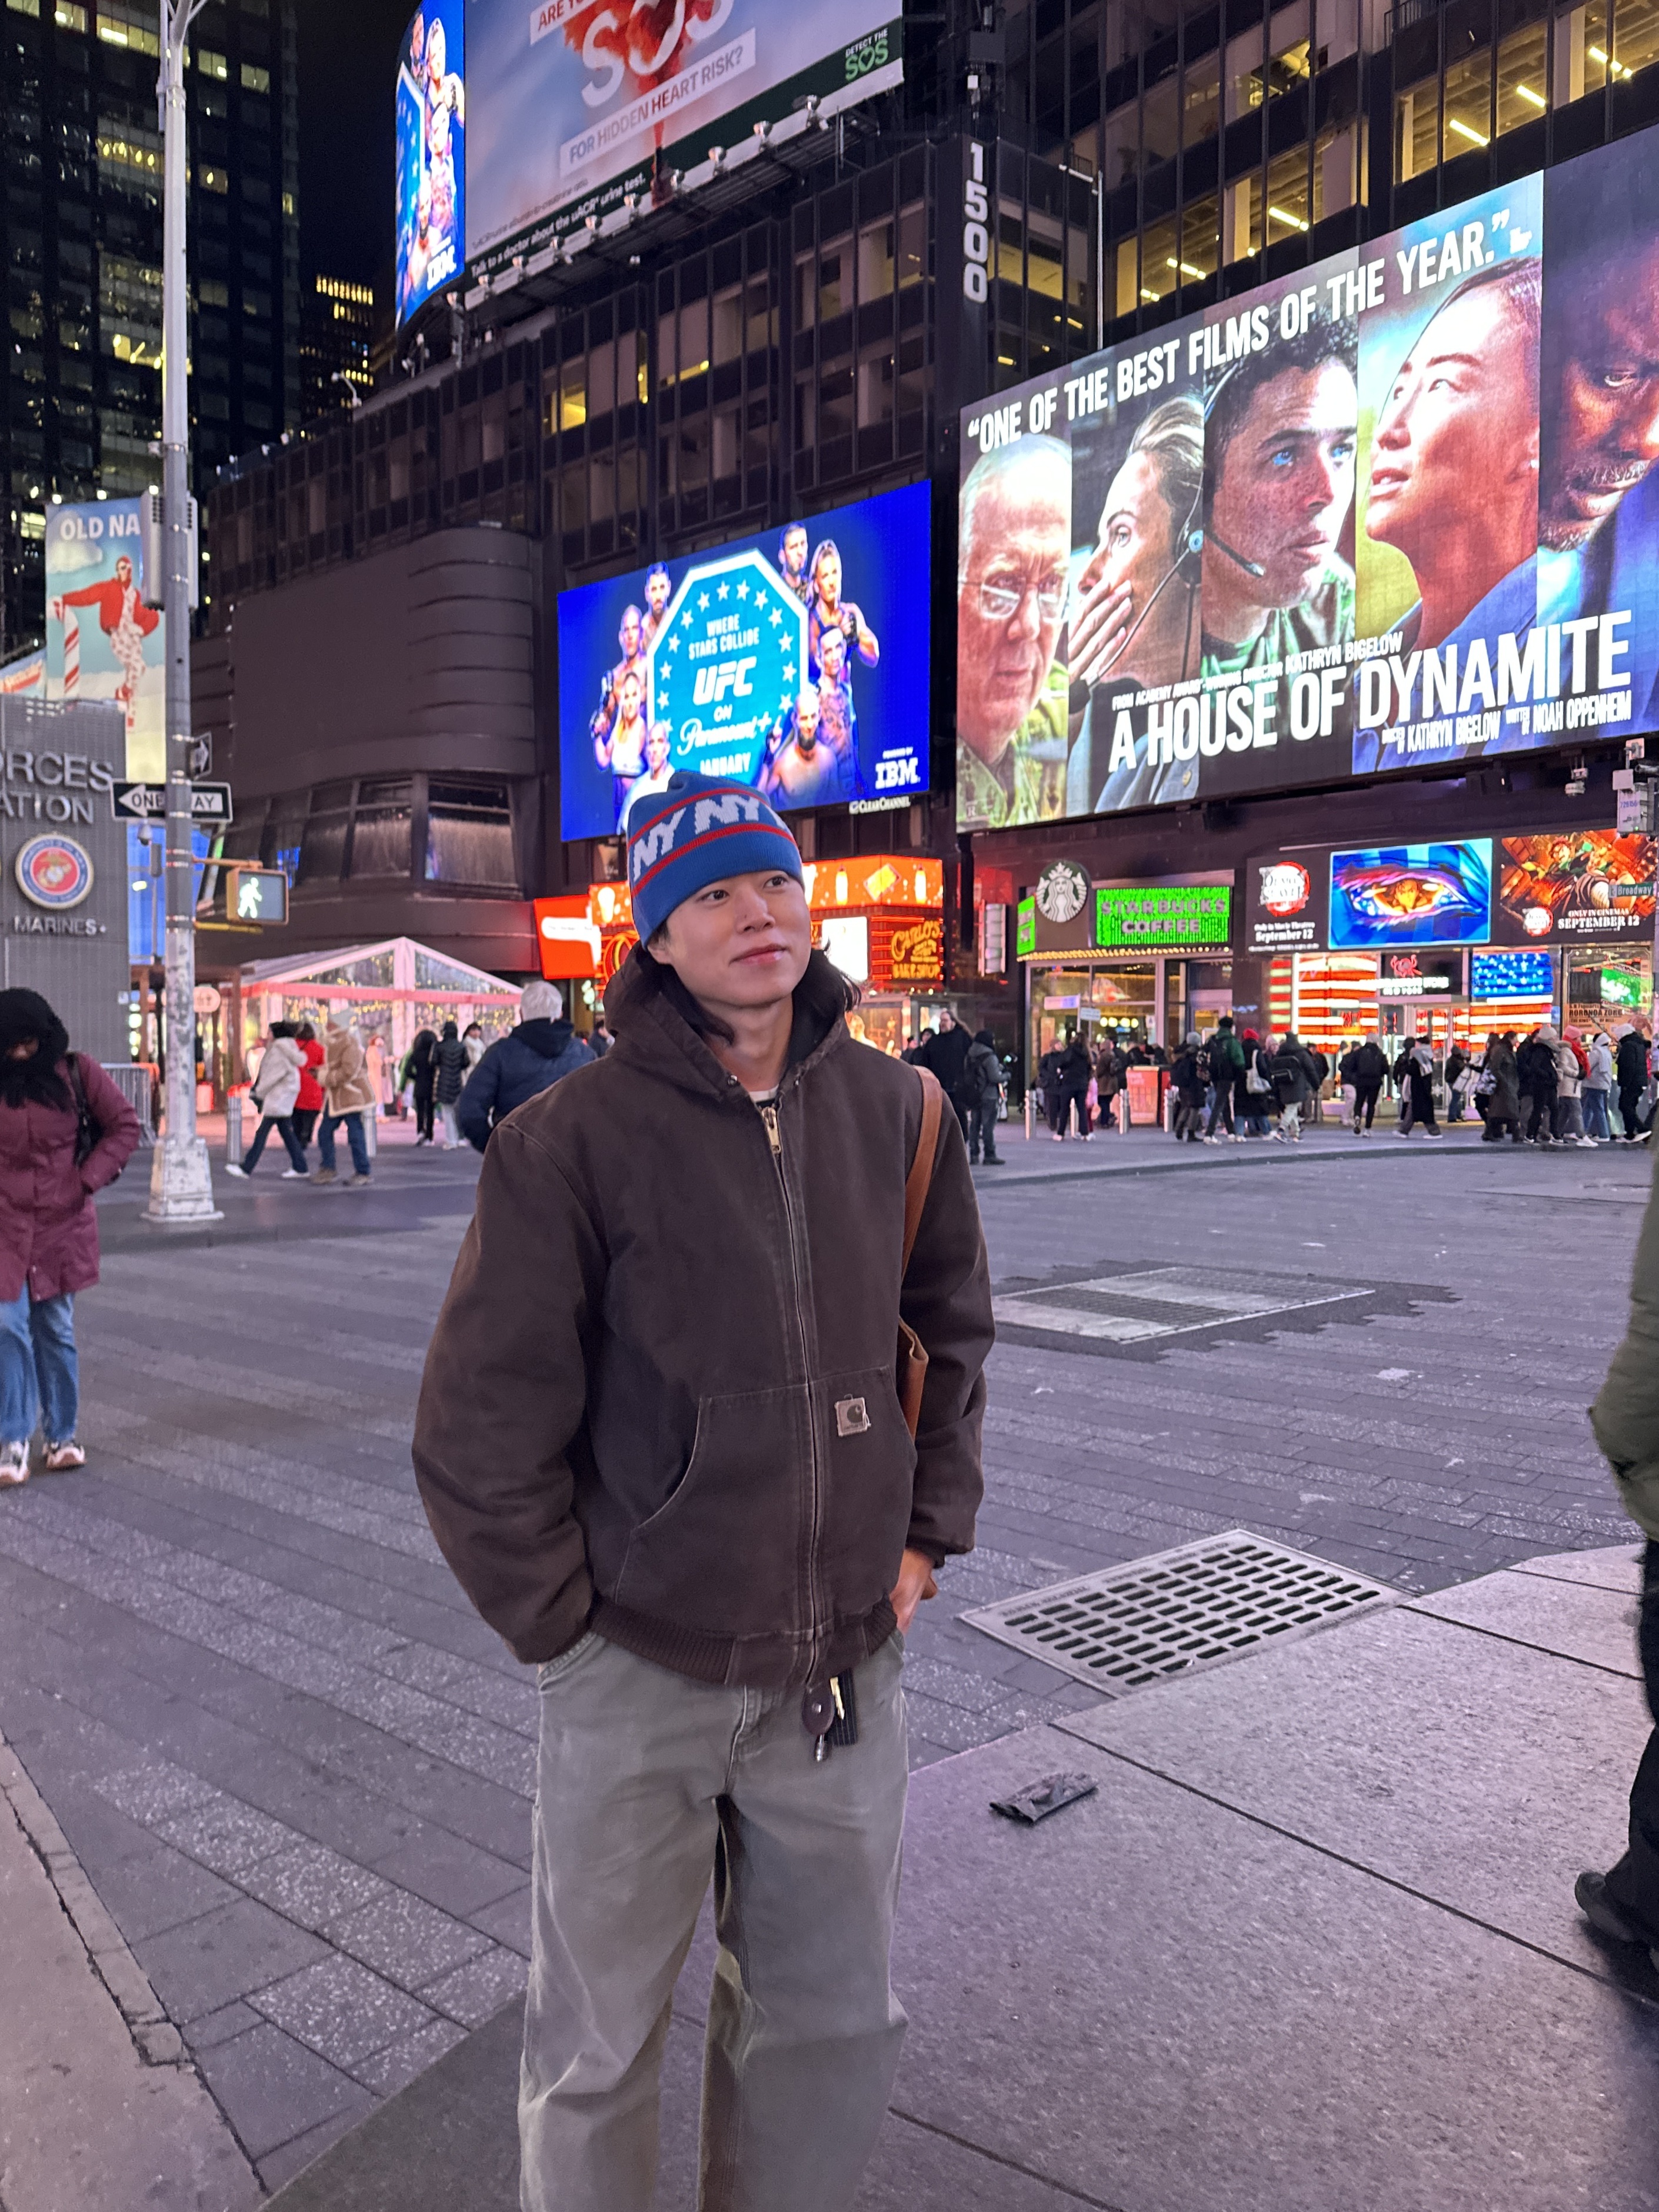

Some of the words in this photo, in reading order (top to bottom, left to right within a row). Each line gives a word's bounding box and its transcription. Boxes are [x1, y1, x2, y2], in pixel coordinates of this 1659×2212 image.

[538, 0, 565, 31] ARE
[845, 36, 872, 58] DETECT
[874, 28, 888, 42] THE
[845, 38, 889, 81] SOS
[569, 135, 595, 164] FOR
[597, 102, 647, 147] HIDDEN
[651, 71, 699, 115] HEART
[701, 45, 744, 85] RISK?
[471, 258, 487, 278] Talk
[488, 256, 497, 268] to
[504, 237, 530, 261] doctor
[531, 222, 554, 245] about
[555, 214, 570, 231] the
[599, 184, 624, 206] urine
[964, 142, 988, 304] 1500
[1029, 387, 1058, 434] OF
[1064, 367, 1108, 421] THE
[1117, 339, 1180, 402] BEST
[1188, 305, 1270, 376] FILMS
[1280, 285, 1317, 340] OF
[1327, 258, 1385, 322] THE
[61, 517, 104, 541] OLD
[109, 513, 141, 538] NA
[707, 614, 740, 638] WHERE
[688, 638, 718, 661] STARS
[719, 627, 760, 653] COLLIDE
[692, 656, 757, 705] UFC
[1112, 692, 1134, 711] FROM
[1135, 685, 1172, 707] ACADEMY
[1242, 662, 1284, 685] DIRECTOR
[1286, 645, 1342, 675] KATHRYN
[1344, 631, 1404, 662] BIGELOW
[1108, 710, 1137, 773] A
[1147, 680, 1279, 767] HOUSE
[1290, 666, 1347, 741] OF
[1359, 609, 1633, 729] DYNAMITE
[714, 704, 733, 722] ON
[1407, 718, 1453, 754] KATHRYN
[1455, 711, 1501, 746] BIGELOW
[1533, 700, 1564, 735] NOAH
[1566, 689, 1633, 729] OPPENHEIM
[0, 751, 113, 792] RCES
[700, 752, 751, 778] JANUARY
[875, 757, 919, 790] IBM
[131, 792, 165, 808] ONE
[192, 793, 215, 808] AY
[633, 807, 687, 882] NY
[694, 794, 760, 835] NY
[1101, 898, 1225, 915] STARBUCKS
[1617, 884, 1653, 897] Broadway
[15, 915, 98, 936] MARINES
[1121, 918, 1200, 934] COFFEE
[1255, 929, 1302, 944] September
[1302, 928, 1314, 940] 12
[1558, 915, 1626, 930] SEPTEMBER
[1627, 915, 1640, 927] 12
